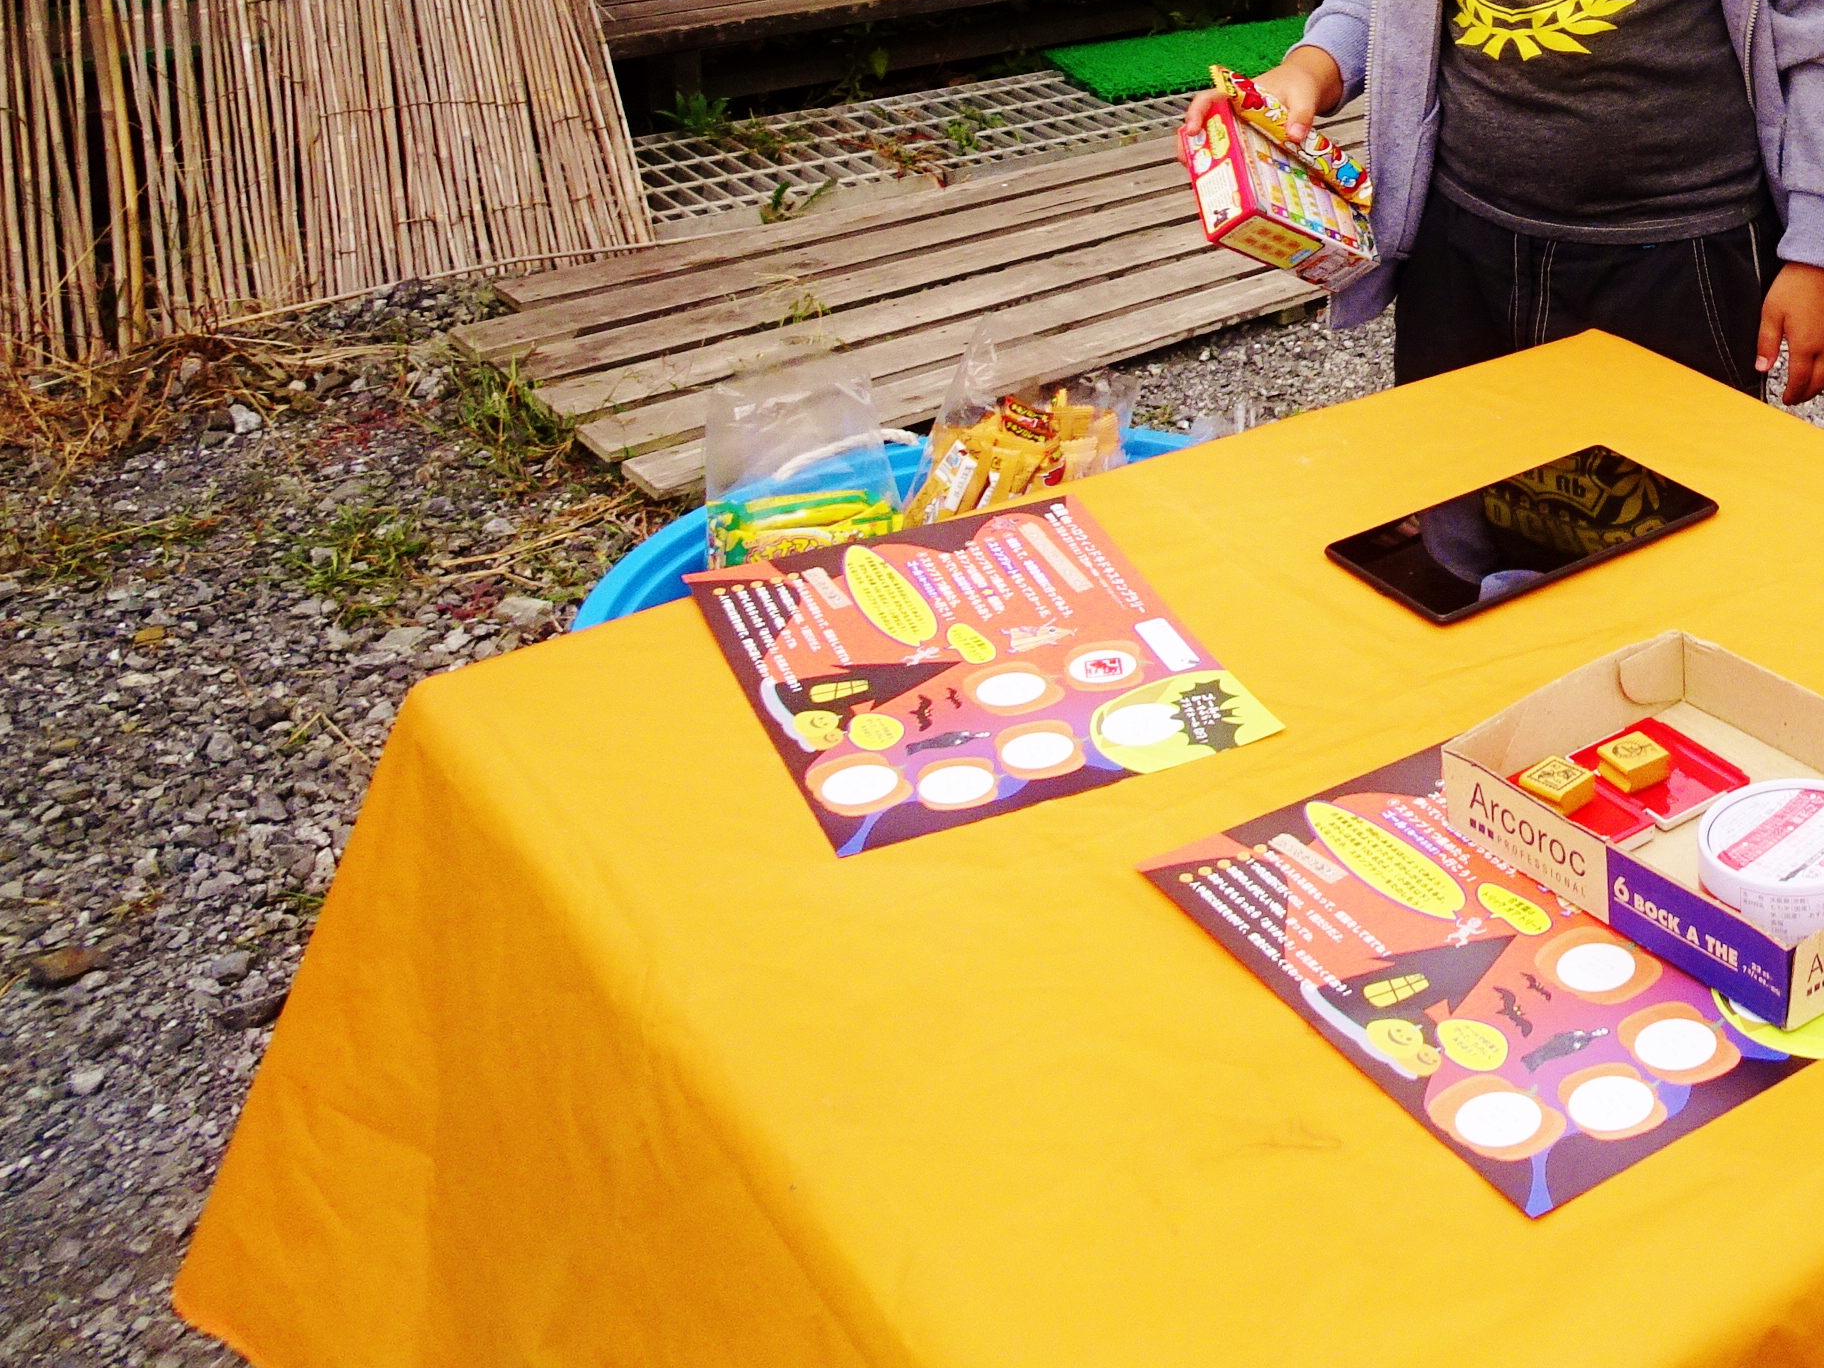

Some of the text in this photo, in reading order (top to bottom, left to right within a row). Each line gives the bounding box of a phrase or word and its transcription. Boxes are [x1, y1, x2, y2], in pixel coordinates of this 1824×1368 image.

[1469, 782, 1586, 877] Arcoroc
[1497, 834, 1587, 899] PROFESSIONAL
[1613, 876, 1739, 968] 6 BOCK A THE
